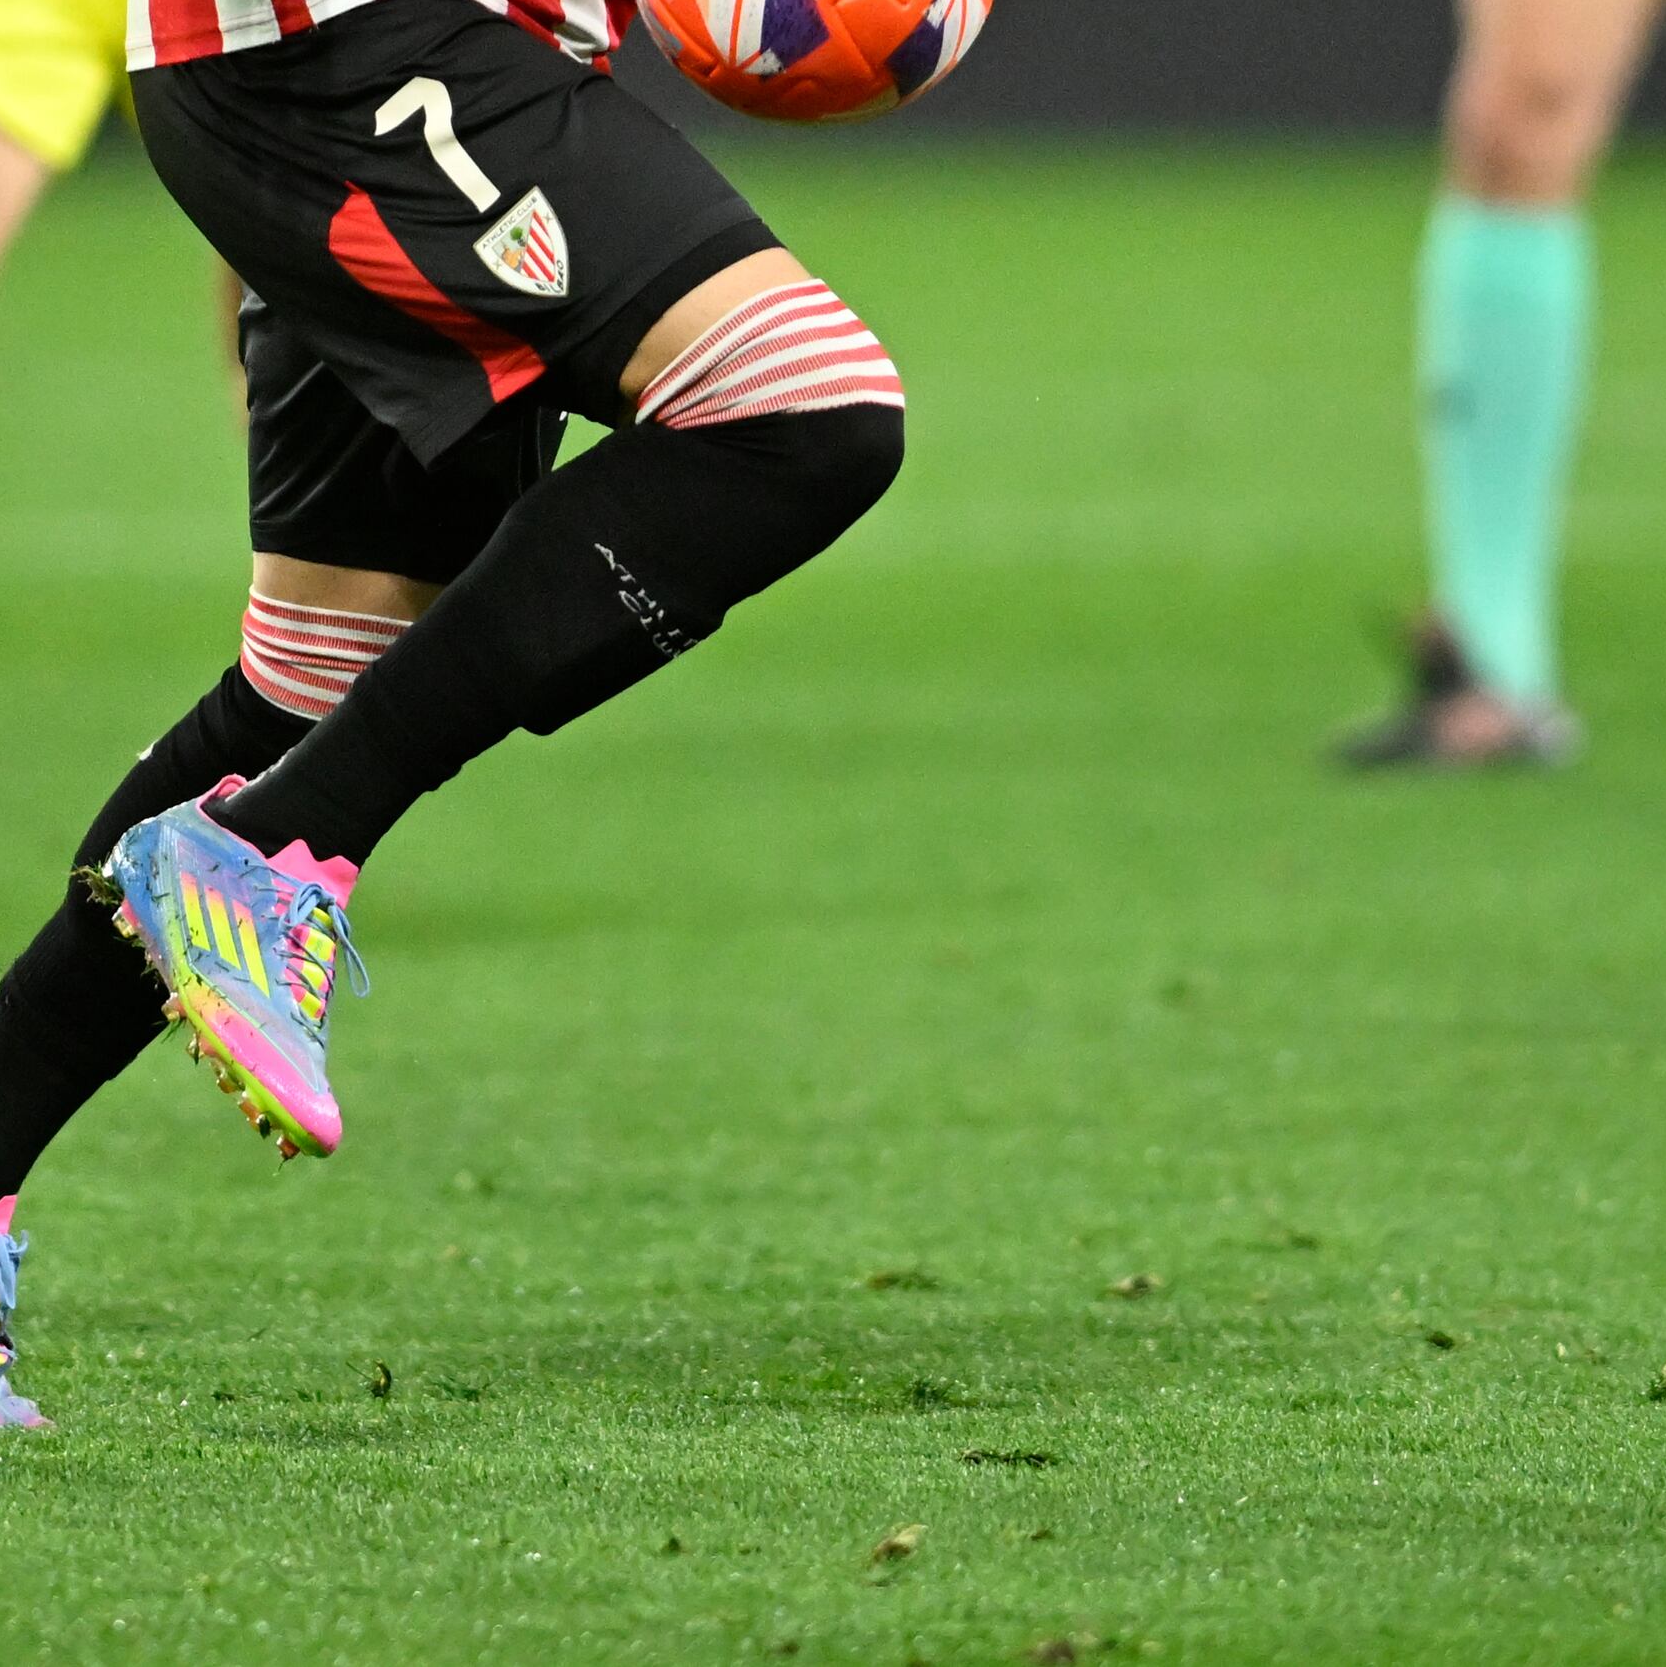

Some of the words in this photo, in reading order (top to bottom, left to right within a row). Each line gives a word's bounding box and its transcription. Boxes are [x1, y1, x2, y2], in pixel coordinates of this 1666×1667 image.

[374, 75, 501, 213] 7
[482, 216, 517, 250] ATHLETIC
[516, 196, 539, 216] CLUB
